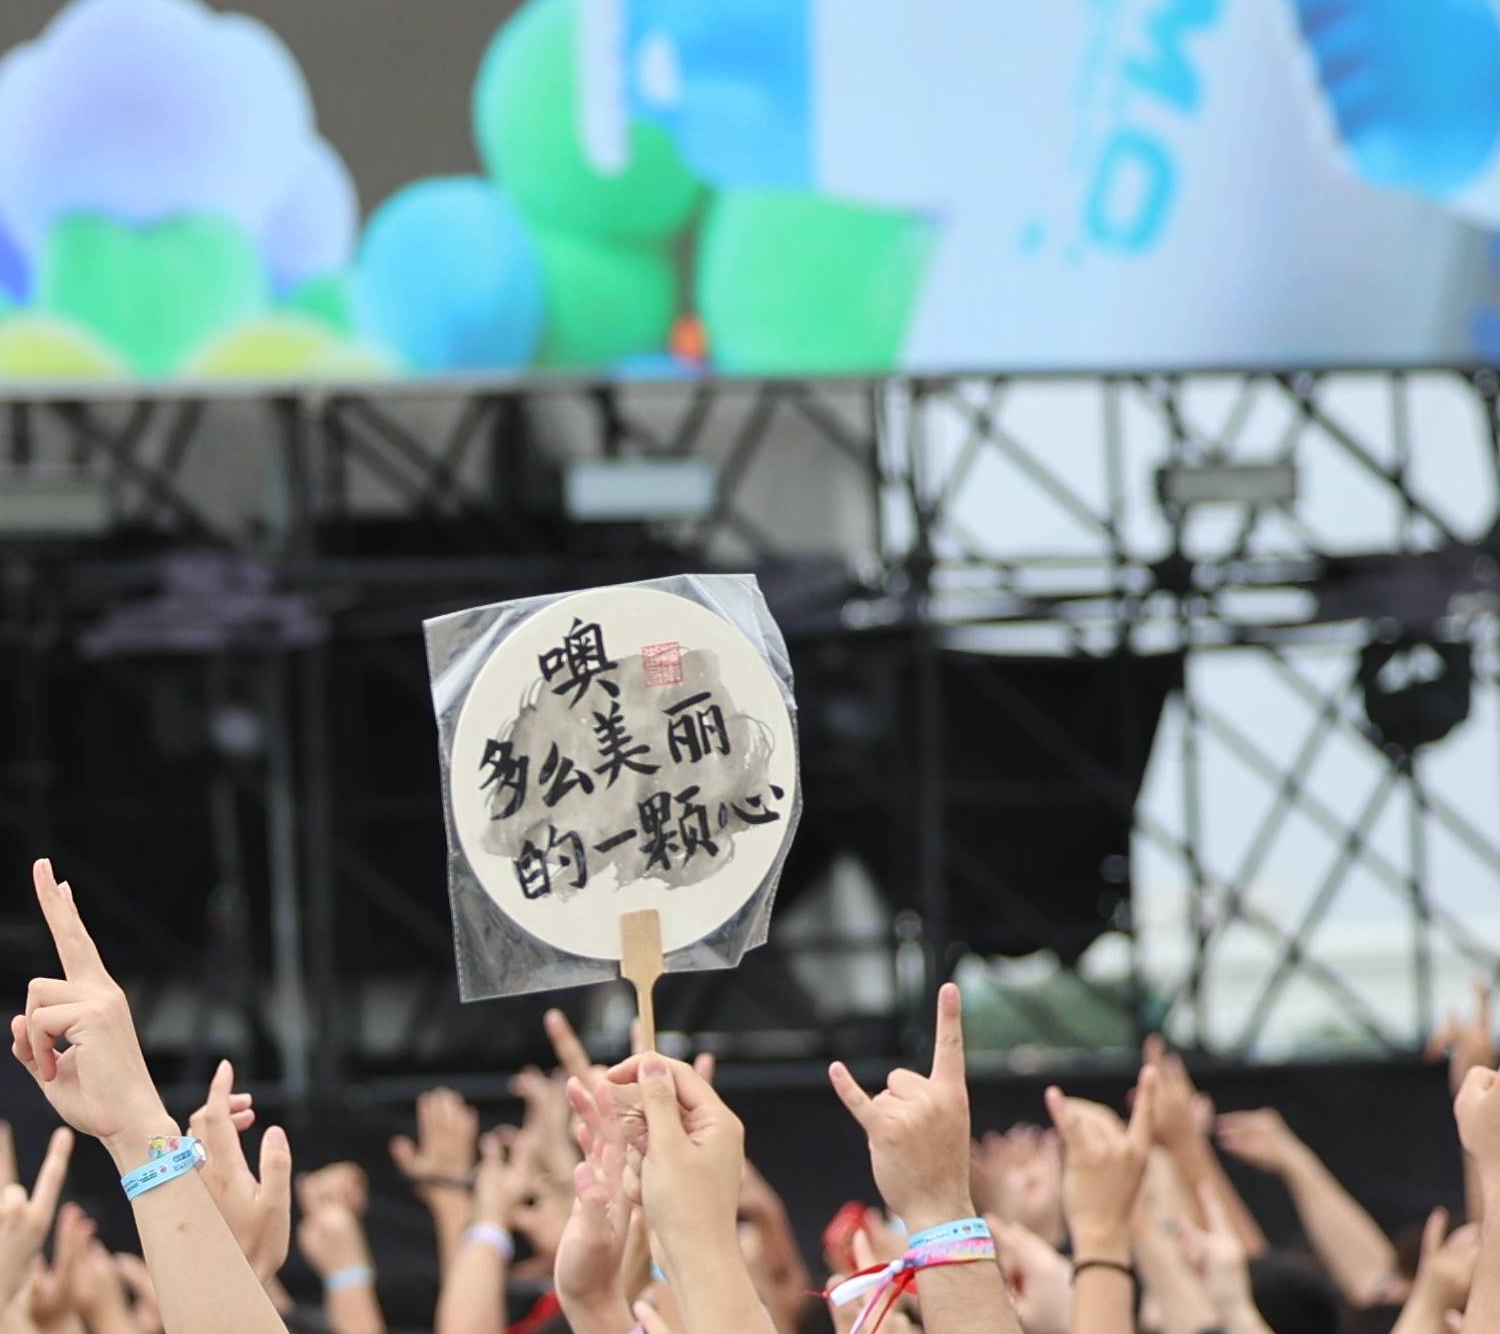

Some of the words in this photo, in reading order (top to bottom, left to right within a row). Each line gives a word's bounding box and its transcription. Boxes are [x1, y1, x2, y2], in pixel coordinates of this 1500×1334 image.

[538, 618, 619, 709] 噢
[478, 691, 731, 820] 多么美丽
[513, 784, 785, 900] 的一颗心
